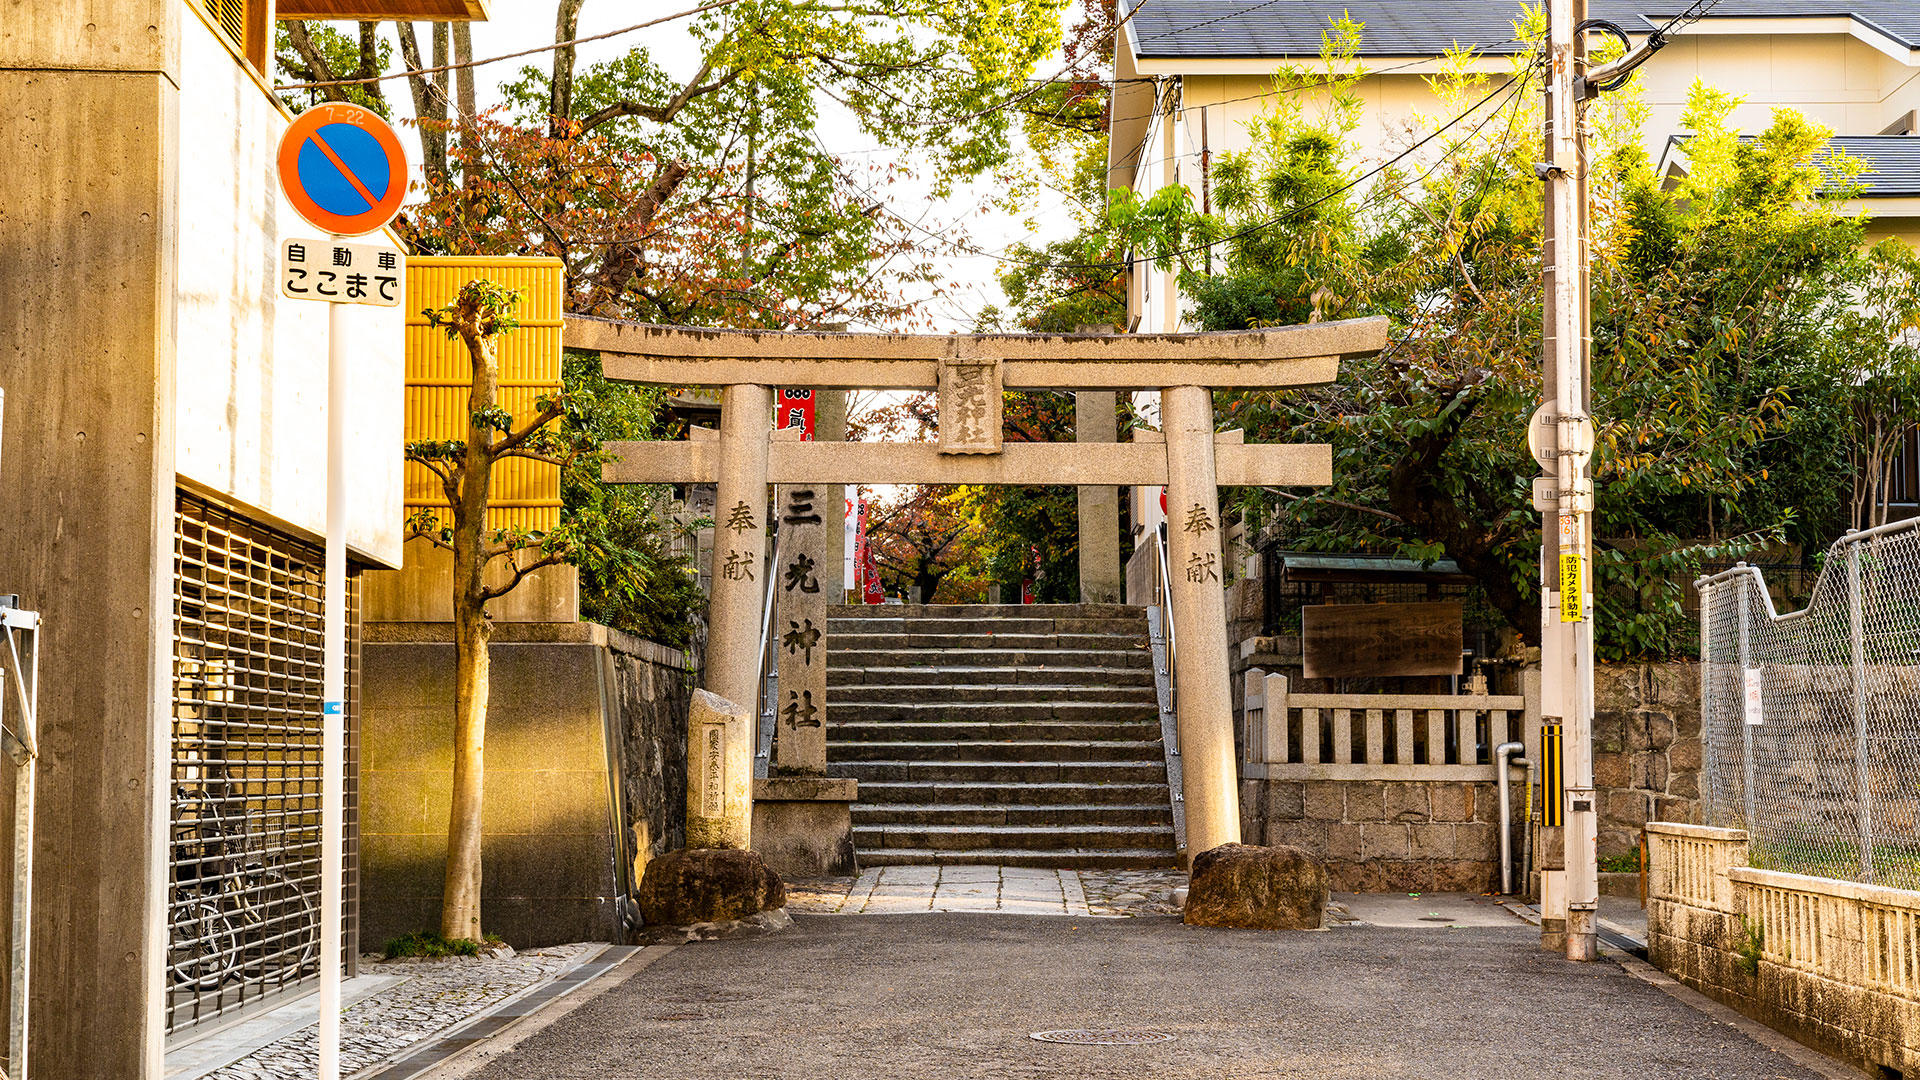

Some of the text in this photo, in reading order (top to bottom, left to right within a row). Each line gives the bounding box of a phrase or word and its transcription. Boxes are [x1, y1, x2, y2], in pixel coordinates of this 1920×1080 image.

[325, 106, 365, 125] 7-22
[286, 268, 398, 301] ここまで
[287, 243, 397, 271] 自動車
[722, 500, 759, 584] 奉献
[1183, 502, 1219, 585] 奉献
[781, 489, 823, 732] 三光神社
[1565, 556, 1578, 619] 防犯カメラ作動中
